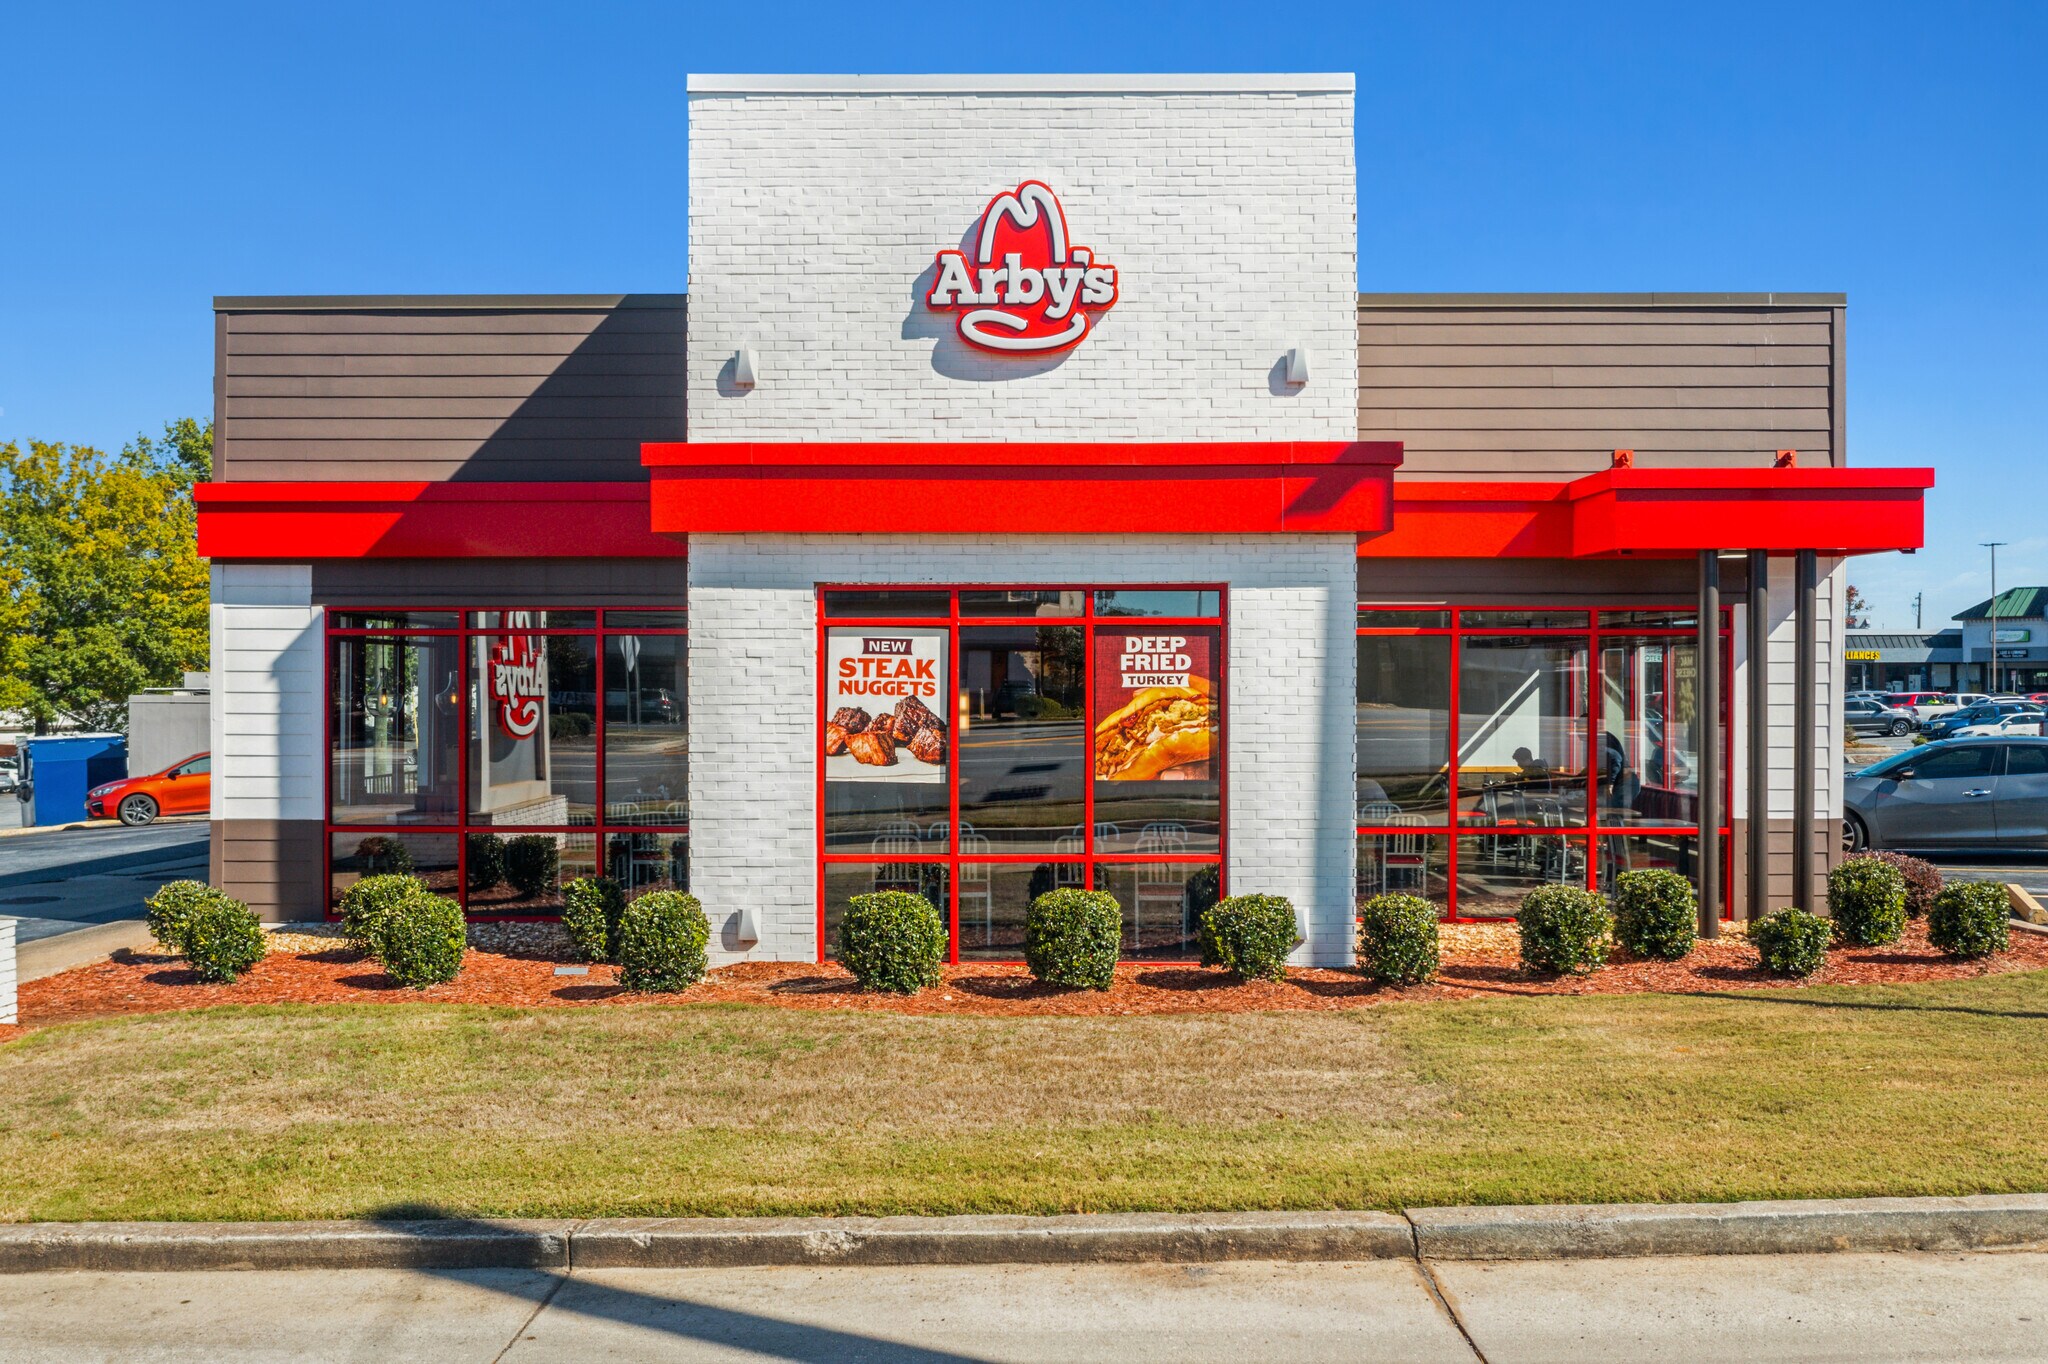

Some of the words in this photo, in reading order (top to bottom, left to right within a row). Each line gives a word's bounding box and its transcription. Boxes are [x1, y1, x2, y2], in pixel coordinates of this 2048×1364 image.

[931, 250, 1114, 319] Arby's
[868, 641, 906, 653] NEW
[1125, 636, 1187, 653] DEEP
[1120, 654, 1192, 671] FRIED
[1845, 650, 1880, 660] LIANCES
[839, 657, 936, 679] STEAK
[838, 680, 936, 697] NUGGETS
[1128, 675, 1184, 686] TURKEY
